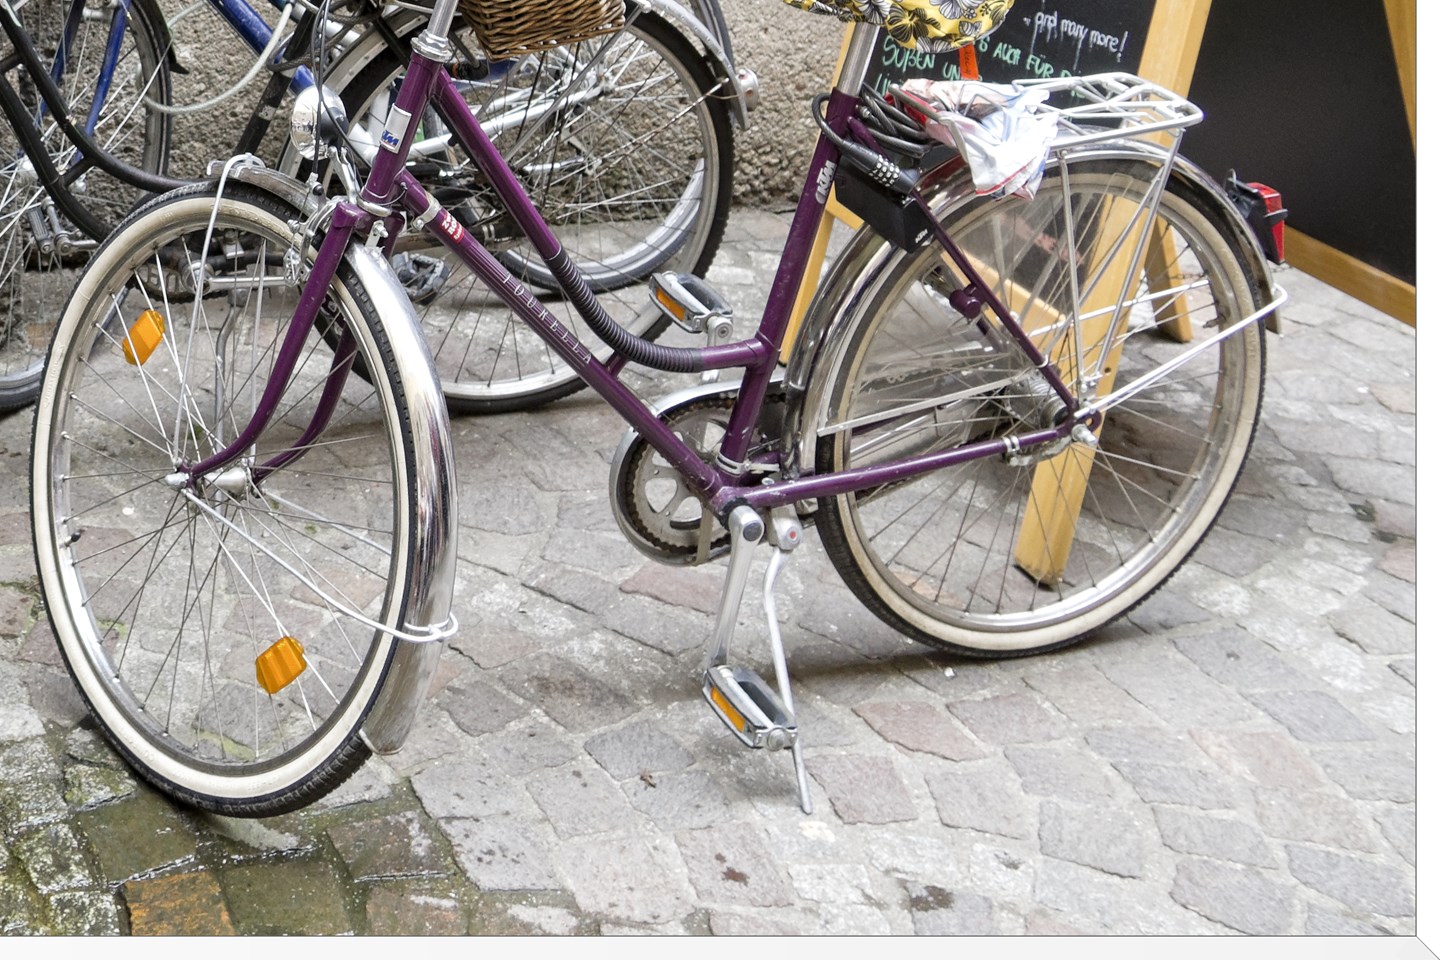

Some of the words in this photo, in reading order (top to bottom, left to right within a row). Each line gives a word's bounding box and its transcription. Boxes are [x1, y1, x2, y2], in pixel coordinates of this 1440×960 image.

[1034, 10, 1058, 30] and
[1060, 17, 1089, 39] many
[992, 41, 1022, 66] AUCH
[1025, 53, 1055, 78] FÜR
[816, 159, 838, 196] KTM
